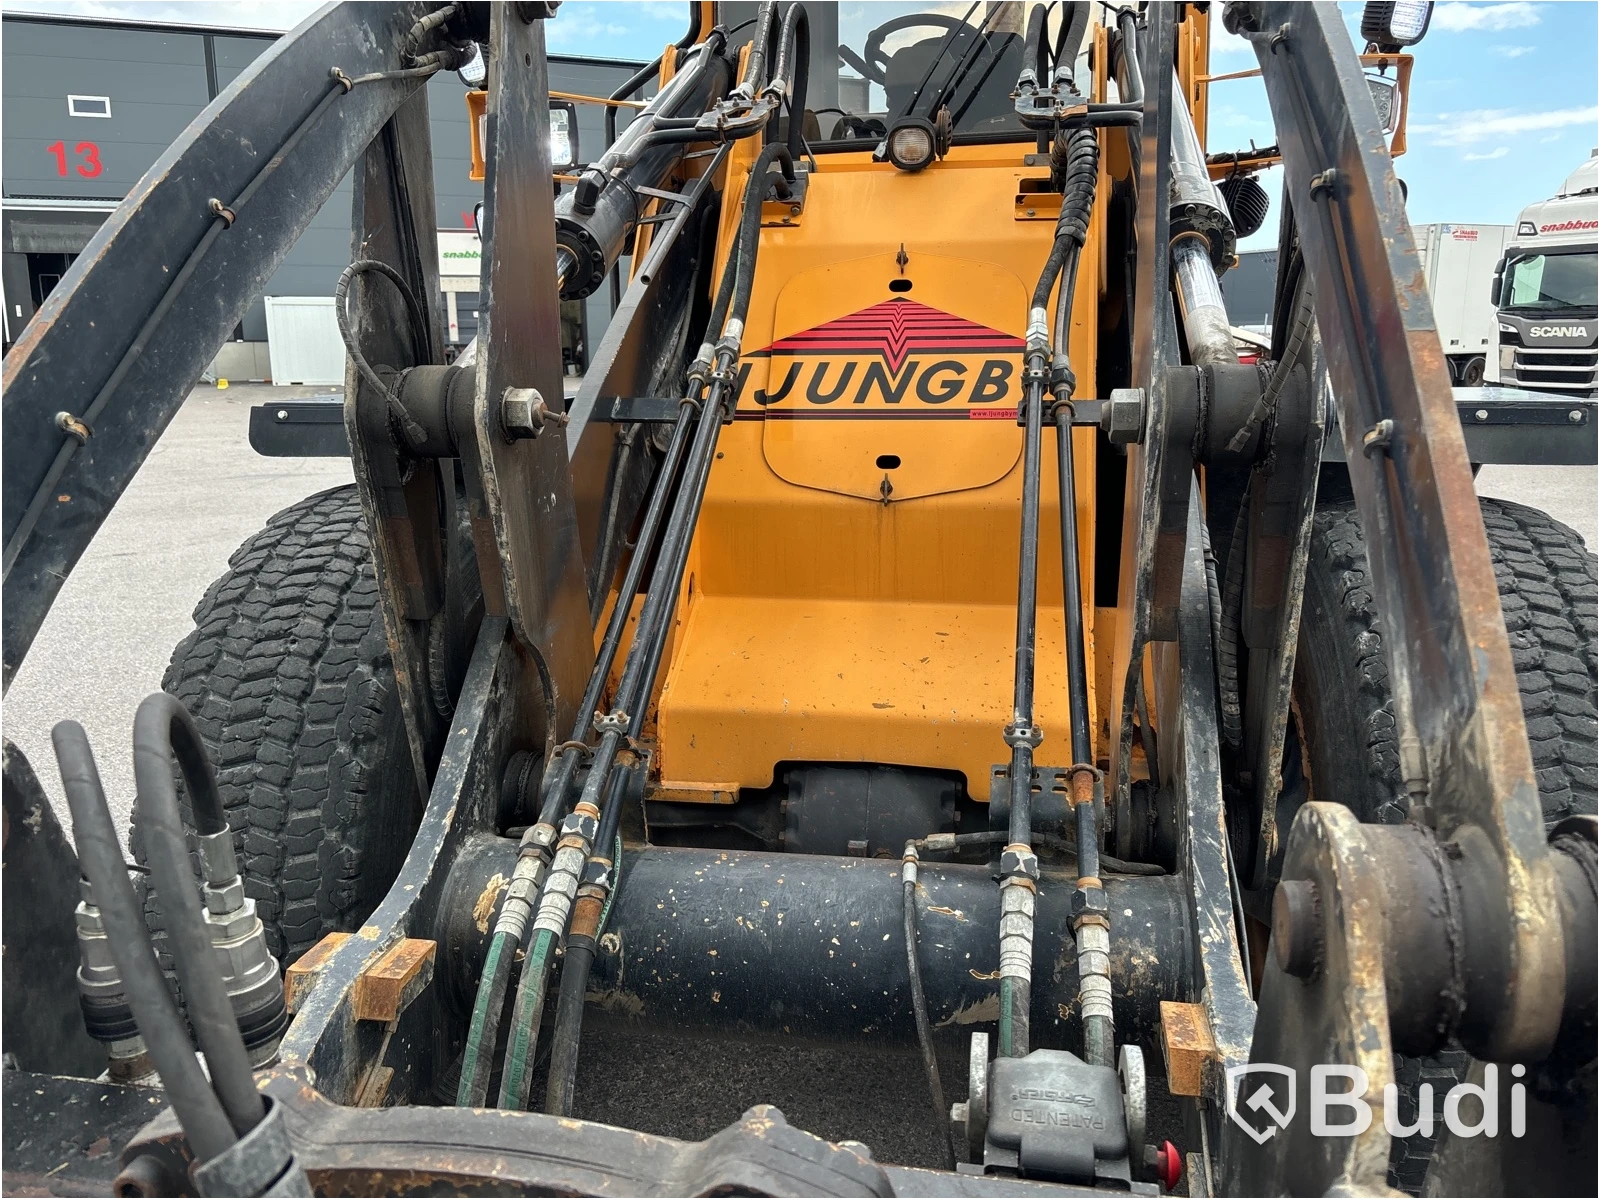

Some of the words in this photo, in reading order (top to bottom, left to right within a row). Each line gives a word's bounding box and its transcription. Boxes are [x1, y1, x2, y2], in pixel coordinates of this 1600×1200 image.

[47, 140, 103, 178] 13
[443, 250, 482, 259] snabb
[1529, 326, 1587, 337] SCANIA
[1011, 1109, 1105, 1130] PATENTED
